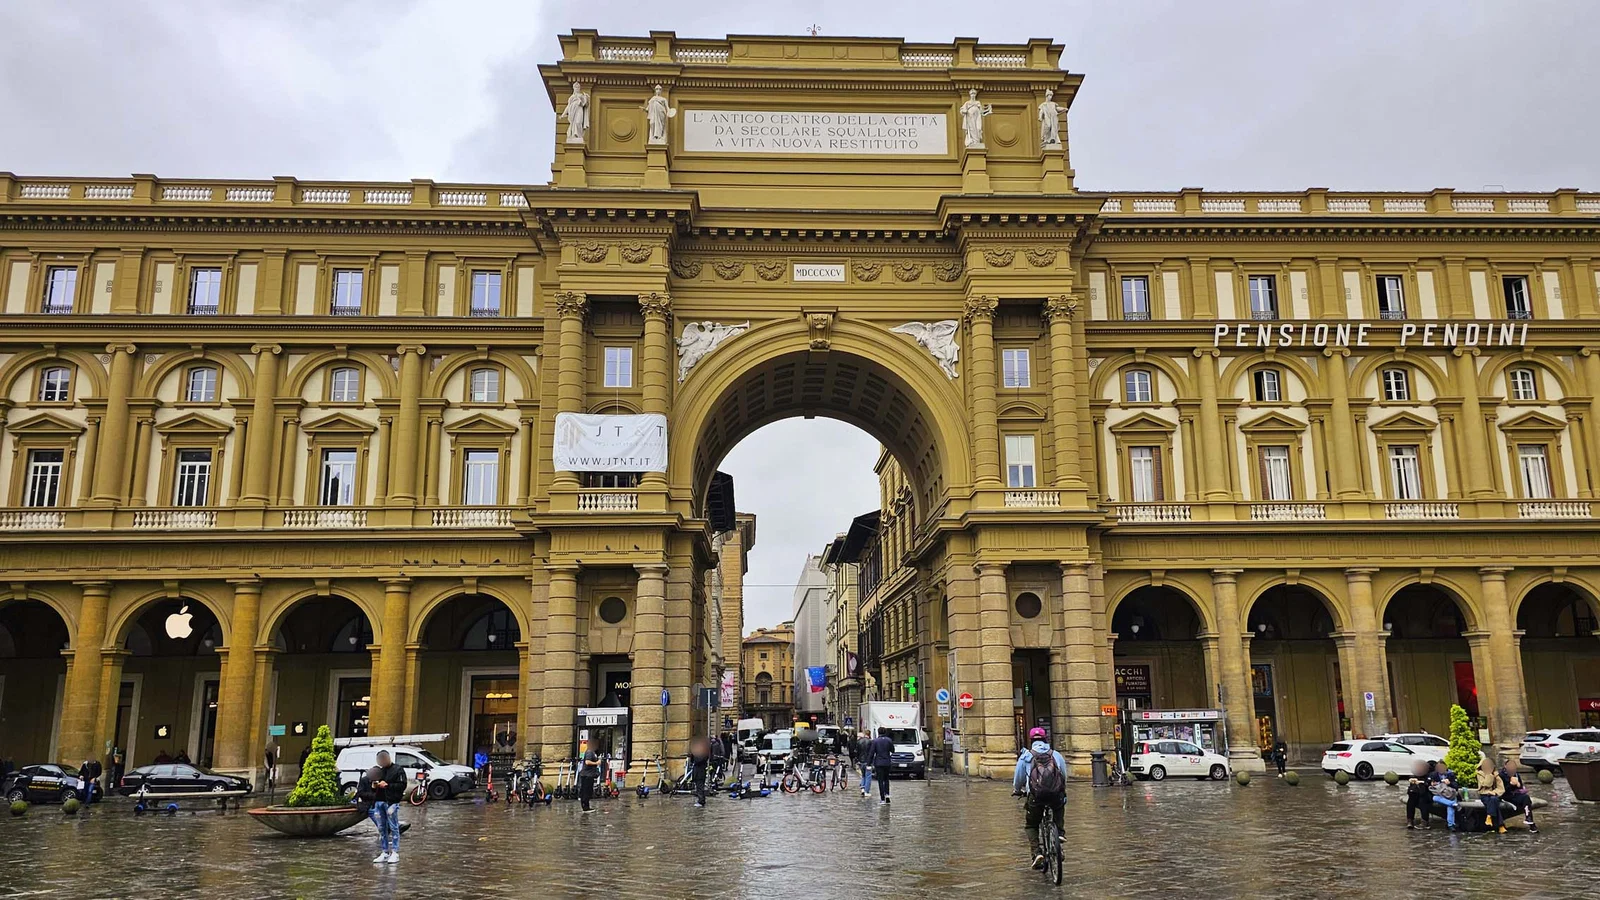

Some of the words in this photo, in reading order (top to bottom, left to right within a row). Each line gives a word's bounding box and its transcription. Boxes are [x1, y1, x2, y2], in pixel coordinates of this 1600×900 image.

[709, 113, 765, 124] ANTICO
[770, 114, 832, 125] CENTRO
[837, 115, 889, 126] DELLA
[714, 125, 734, 136] DA
[741, 125, 821, 137] SECOLARE
[827, 127, 918, 138] SQUALLORE
[715, 138, 724, 148] A
[731, 138, 765, 148] VITA
[772, 138, 822, 149] NUOVA
[829, 139, 919, 150] RESTITUITO
[796, 268, 842, 277] MDCCCXCV
[1213, 323, 1372, 347] PENSIONE
[1400, 323, 1529, 347] PENDINI
[568, 456, 651, 466] WWW.JTNT.IT
[587, 716, 617, 724] VOGUE
